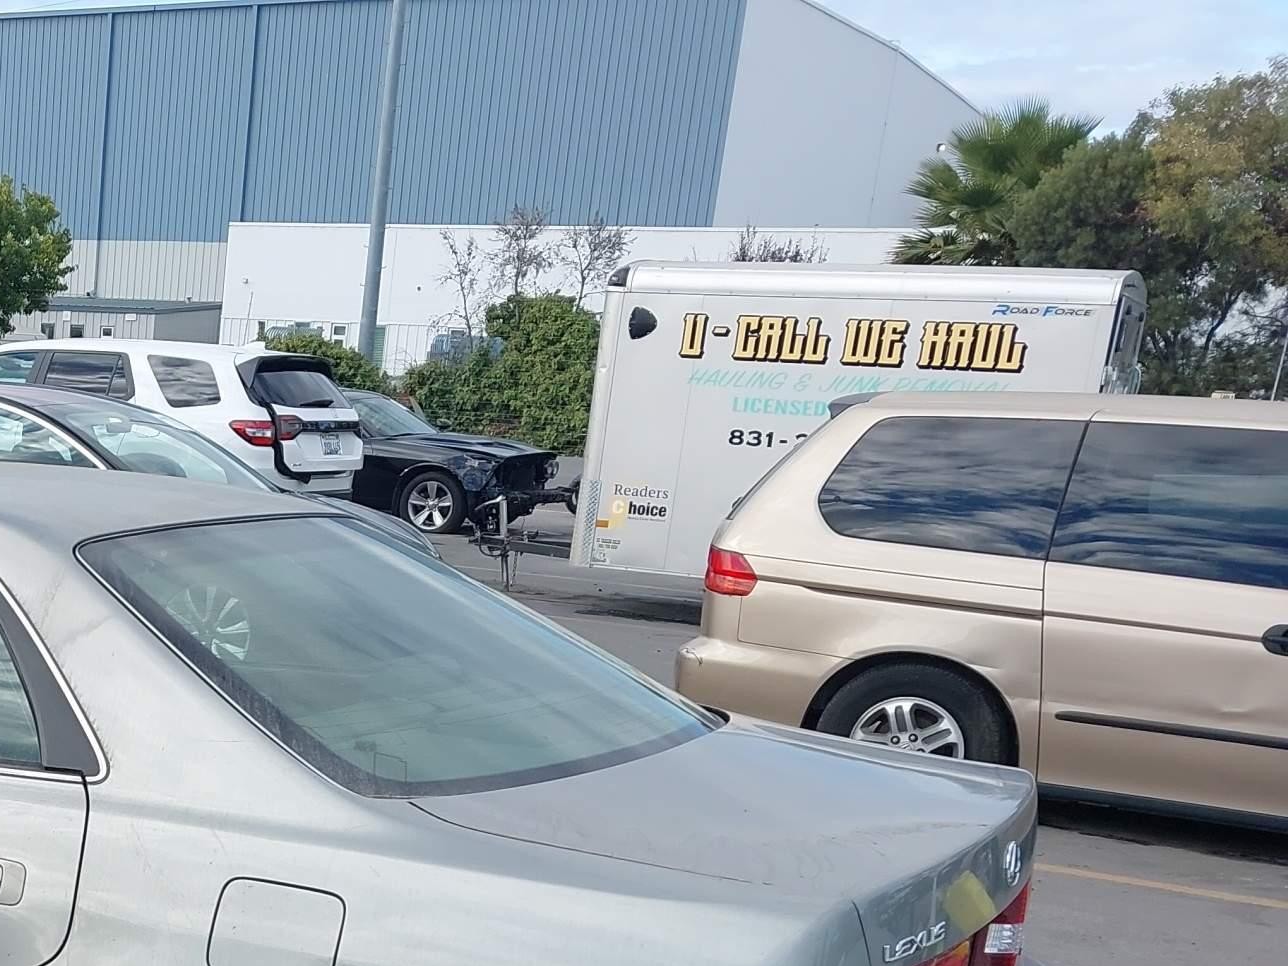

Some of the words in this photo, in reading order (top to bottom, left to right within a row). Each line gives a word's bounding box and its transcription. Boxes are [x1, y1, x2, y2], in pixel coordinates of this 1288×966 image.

[991, 304, 1040, 316] ROAD
[1041, 306, 1094, 317] FORCE
[840, 318, 910, 369] WE
[916, 321, 1028, 374] HAUL
[688, 367, 785, 390] HAULING
[794, 373, 811, 392] &
[818, 374, 887, 393] JUNK
[731, 396, 827, 417] LICENSED
[614, 483, 669, 499] Readers
[883, 921, 946, 962] LEXUS
